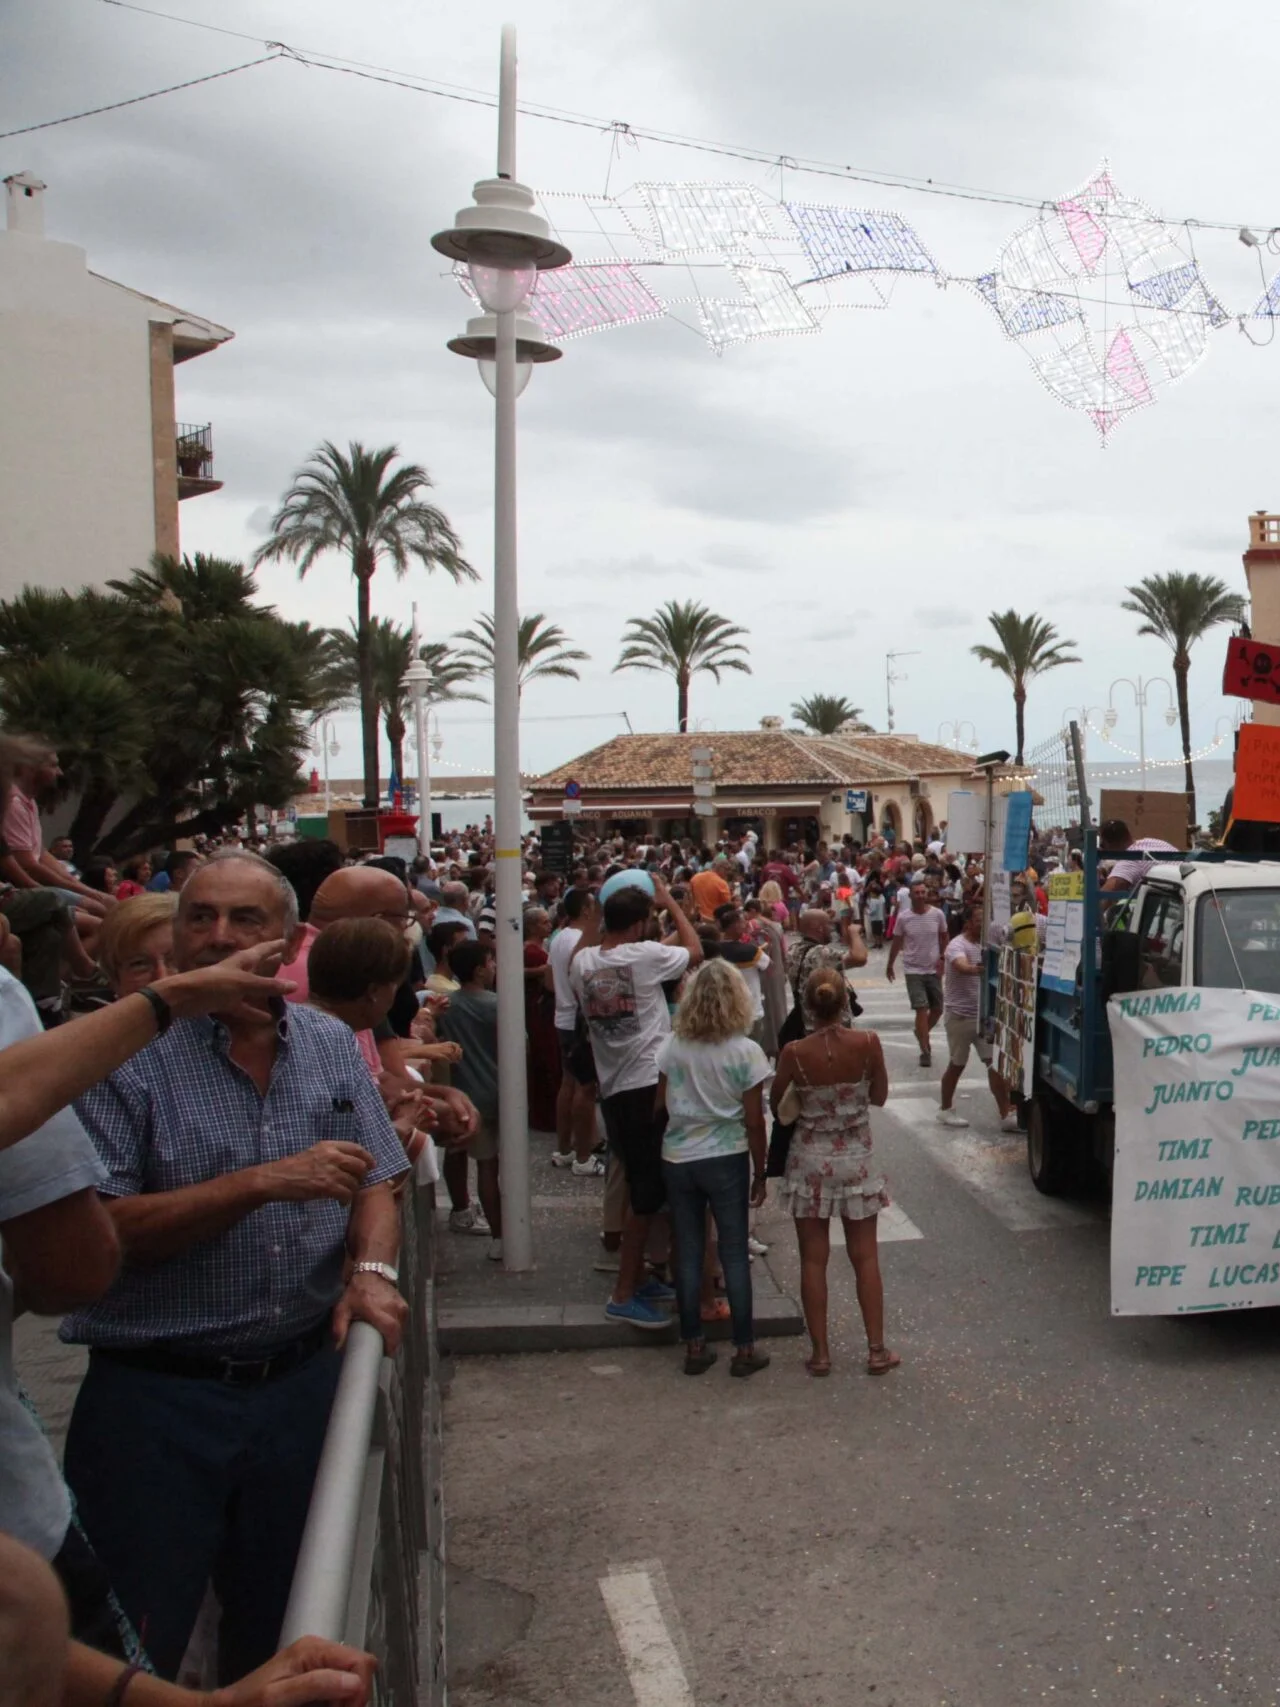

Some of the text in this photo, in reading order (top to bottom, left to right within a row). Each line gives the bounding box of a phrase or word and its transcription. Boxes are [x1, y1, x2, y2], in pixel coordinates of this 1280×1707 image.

[736, 808, 777, 817] TABACOS
[1142, 1032, 1213, 1058] PEDRO
[1144, 1080, 1235, 1115] JUANTO
[1157, 1137, 1213, 1162] TIMI
[1134, 1175, 1224, 1202] DAMIAN
[1189, 1221, 1250, 1247] TIMI
[1134, 1262, 1280, 1289] PEPE LUCAS
